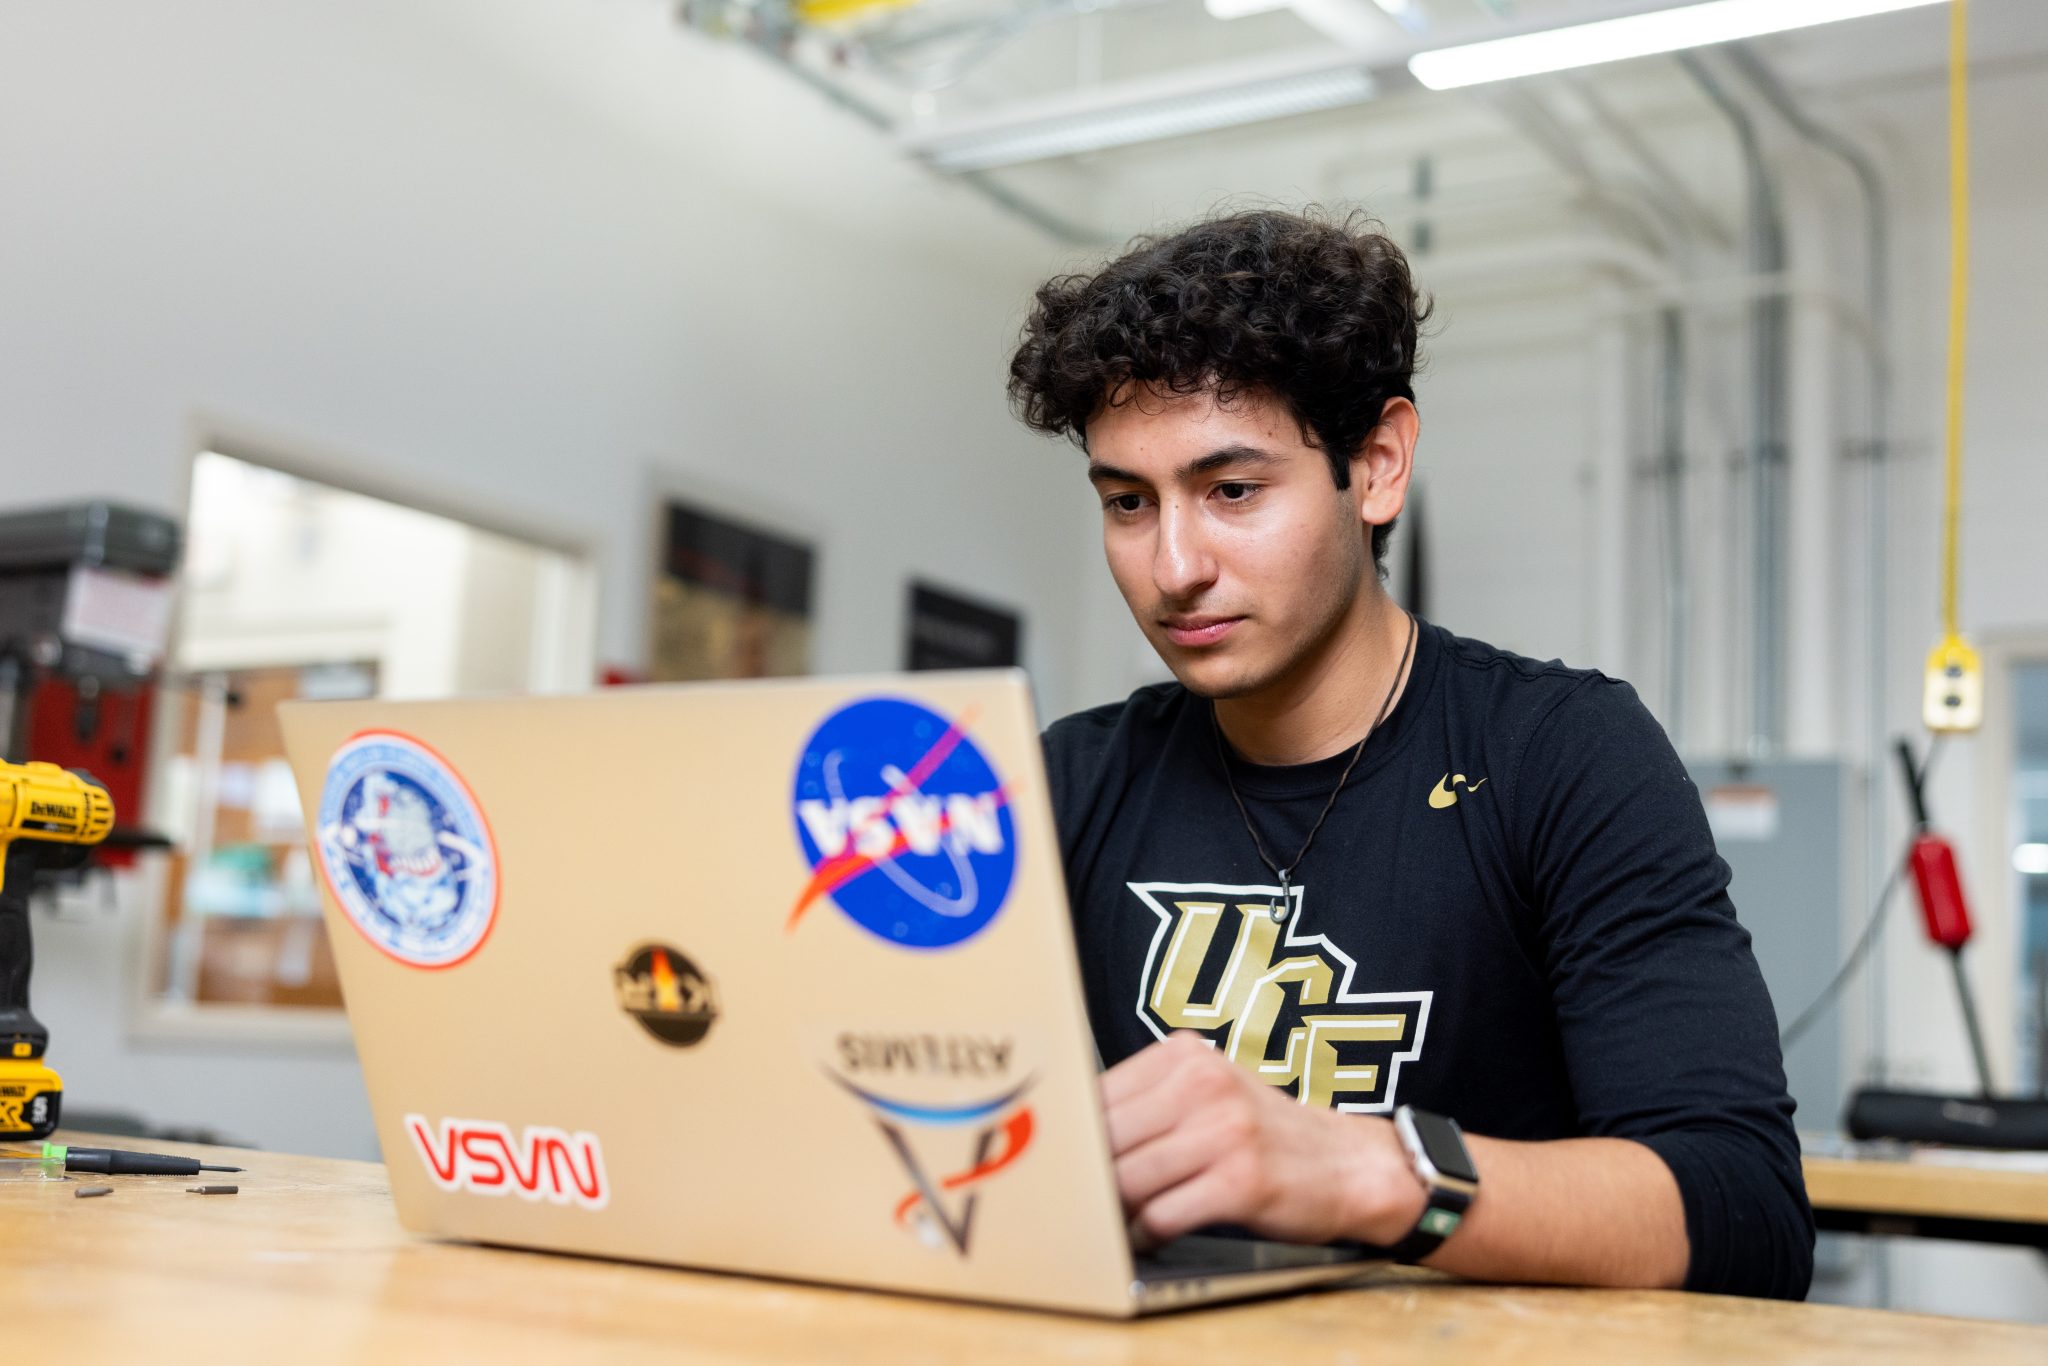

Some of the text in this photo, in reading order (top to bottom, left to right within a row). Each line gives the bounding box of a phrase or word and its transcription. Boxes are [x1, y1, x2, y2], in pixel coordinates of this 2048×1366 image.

[799, 793, 1005, 858] NASA
[1148, 900, 1408, 1113] UCF
[413, 1122, 601, 1199] NASA
